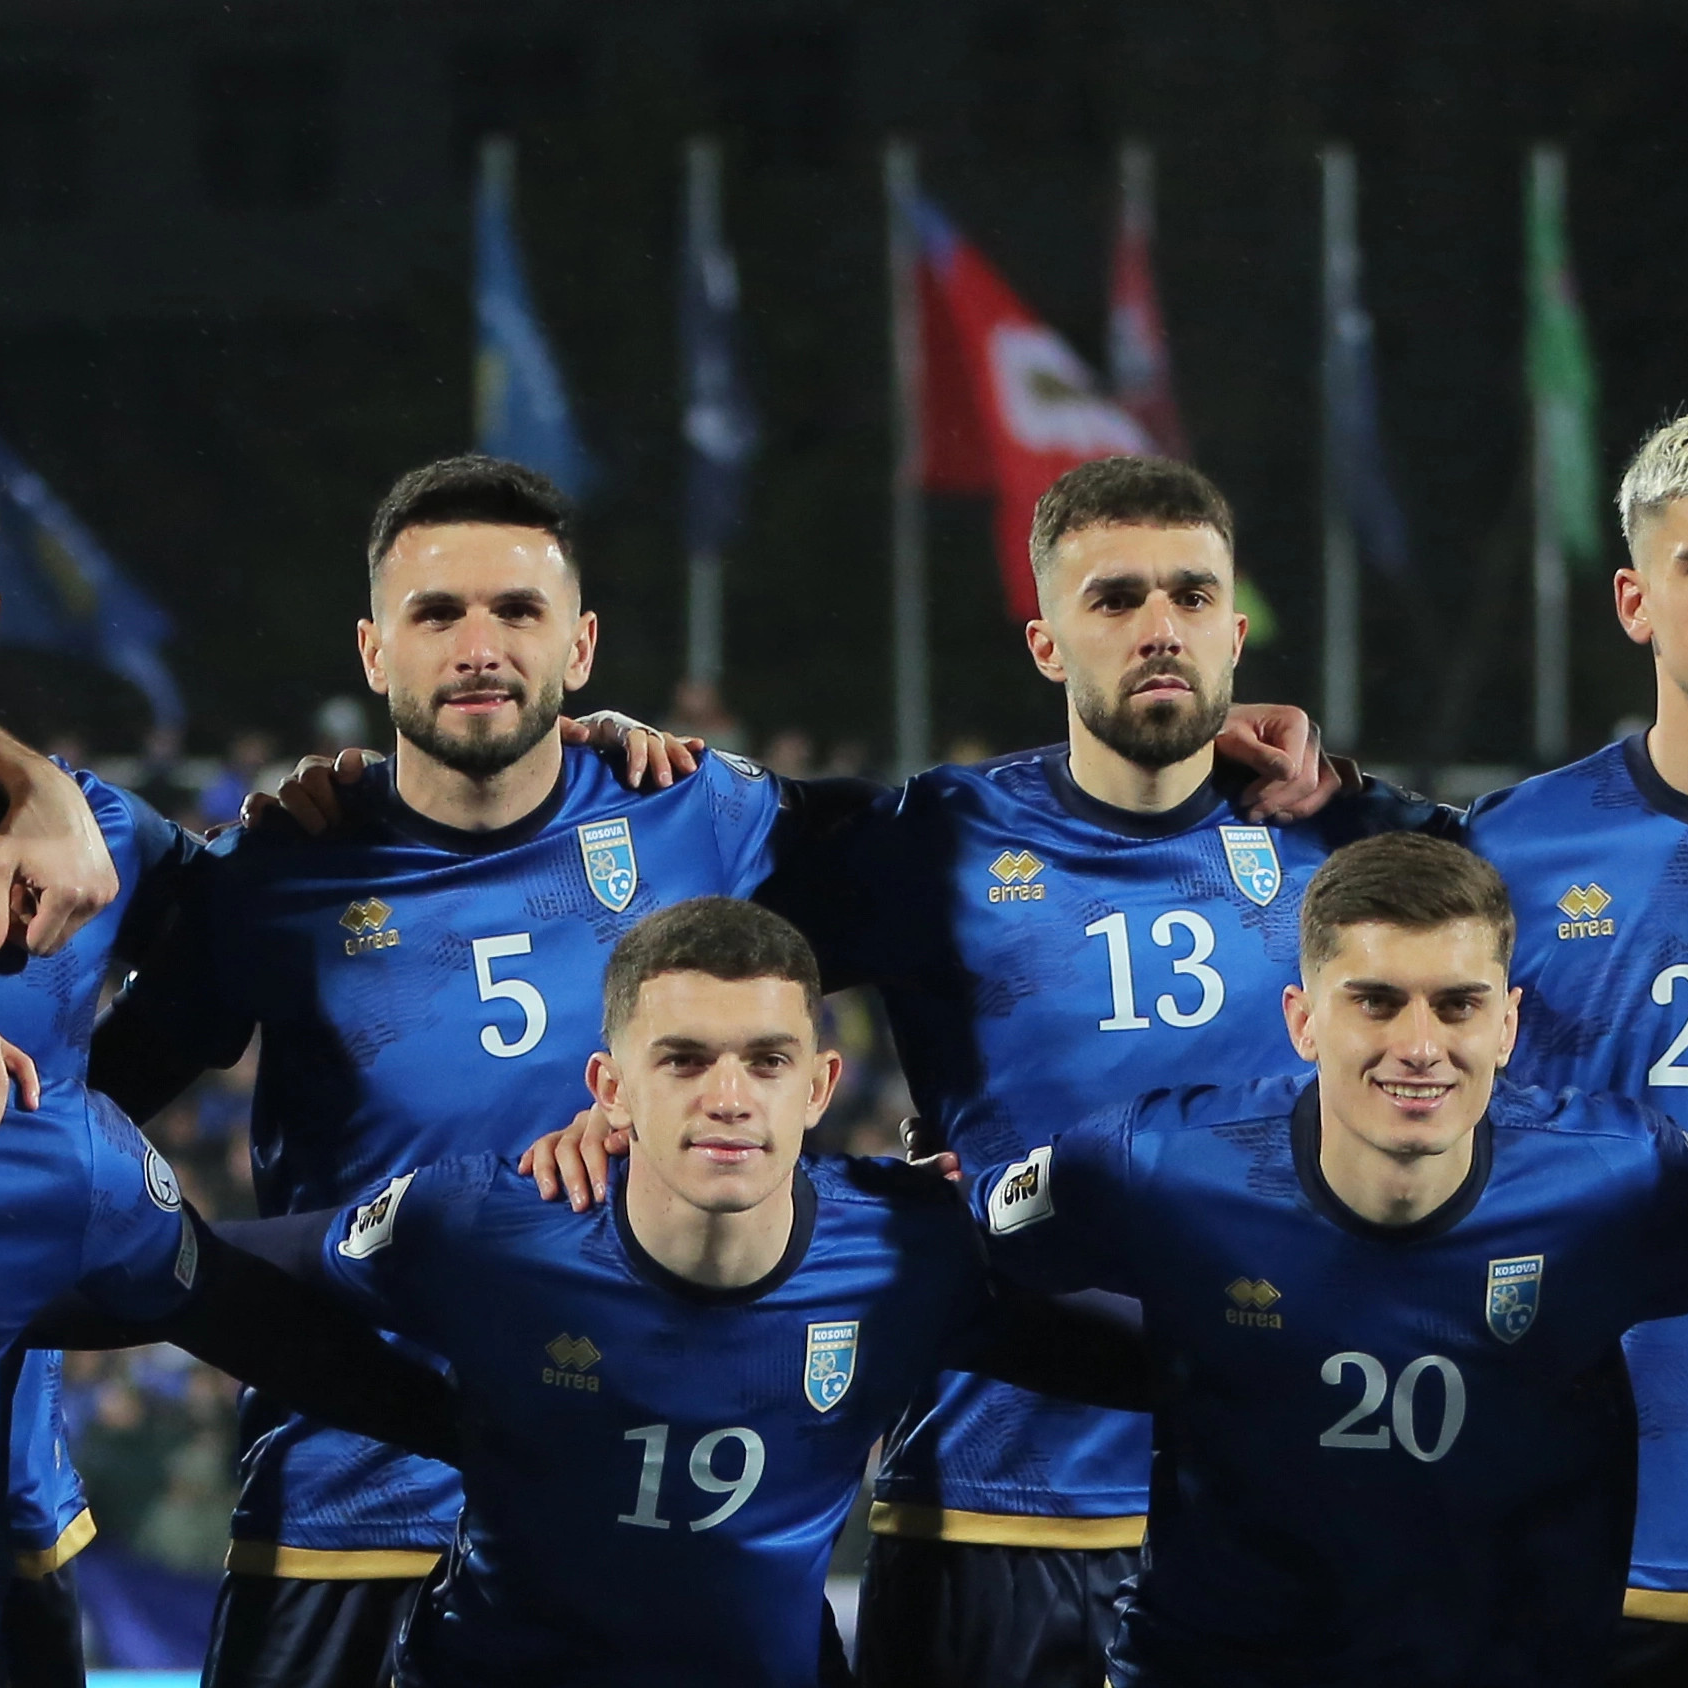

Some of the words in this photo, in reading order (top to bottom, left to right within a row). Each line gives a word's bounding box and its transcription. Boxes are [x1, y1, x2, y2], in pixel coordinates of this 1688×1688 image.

[584, 826, 625, 842] KOSOVA
[1226, 830, 1265, 843] KOSOVA
[987, 883, 1045, 904] errea
[1557, 917, 1615, 940] errea
[345, 928, 401, 956] errea
[1085, 910, 1225, 1031] 13
[472, 932, 547, 1058] 5
[1493, 1262, 1538, 1278] KOSOVA
[1225, 1306, 1283, 1330] errea
[813, 1327, 854, 1342] KOSOVA
[542, 1367, 600, 1392] errea
[1319, 1351, 1466, 1463] 20
[617, 1424, 766, 1532] 19
